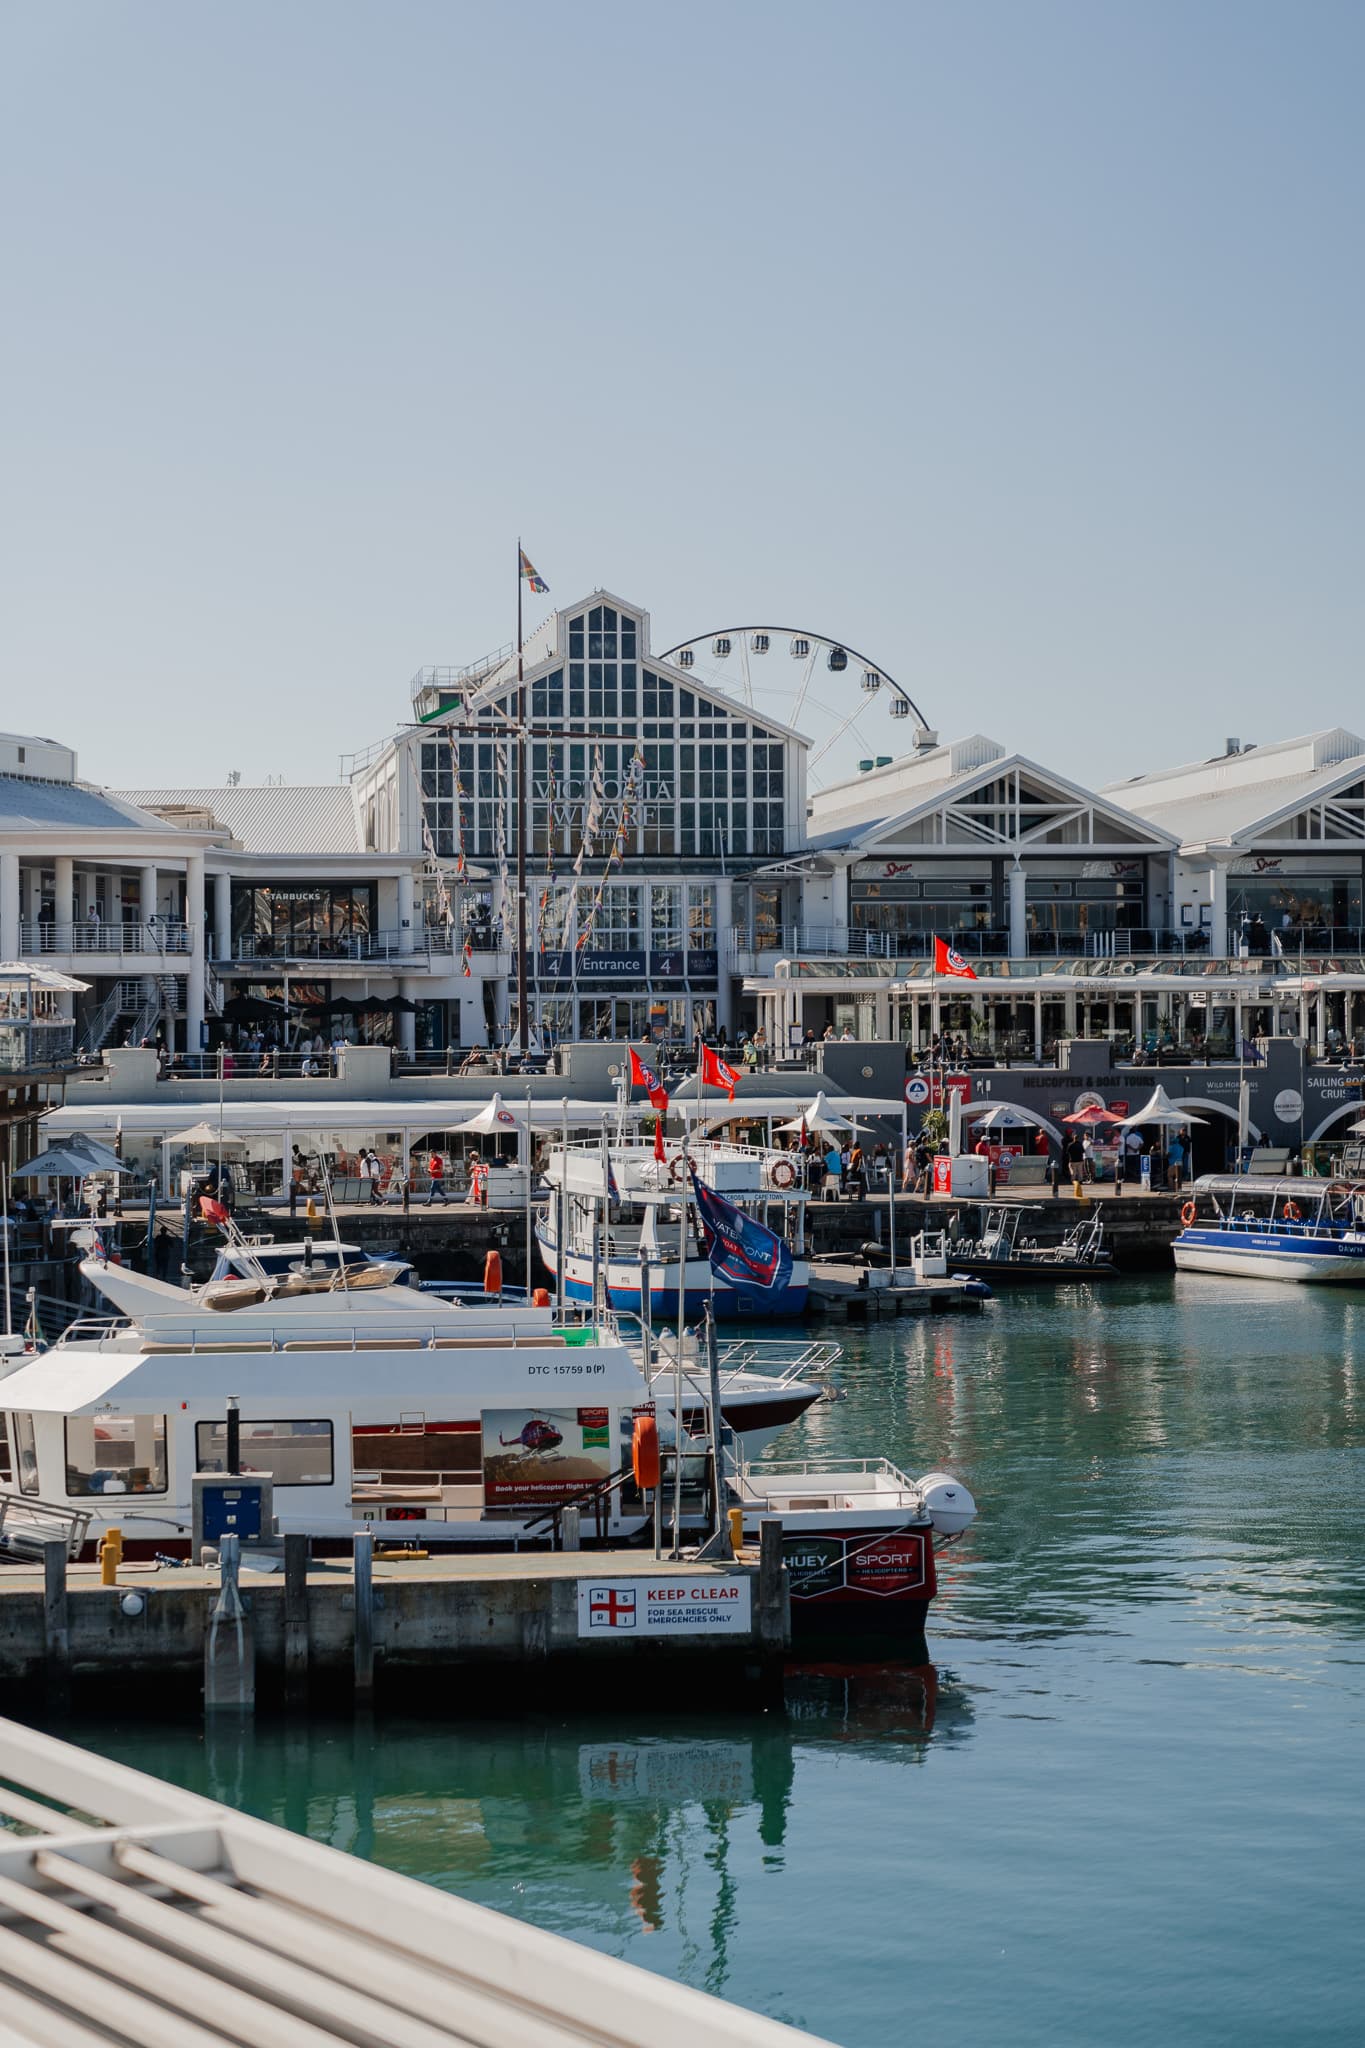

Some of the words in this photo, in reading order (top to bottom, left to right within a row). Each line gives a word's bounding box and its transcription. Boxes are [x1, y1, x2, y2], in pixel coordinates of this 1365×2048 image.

[548, 959, 560, 975] 4
[583, 957, 640, 970] Entrance
[660, 958, 671, 975] 4
[1023, 1077, 1083, 1088] HELICOPTER
[1086, 1076, 1094, 1087] &
[1096, 1076, 1121, 1087] BOAT
[1124, 1076, 1156, 1087] TOURS
[1307, 1077, 1344, 1087] SAILING
[528, 1366, 550, 1374] DTC
[553, 1366, 583, 1374] 15759
[514, 1485, 530, 1493] your
[530, 1484, 565, 1492] helicopter
[783, 1555, 828, 1567] HUEY
[855, 1553, 913, 1566] SPORT
[648, 1590, 685, 1600] KEEP
[691, 1588, 739, 1599] CLEAR
[648, 1616, 707, 1624] EMERGENCIES
[709, 1615, 732, 1623] ONLY
